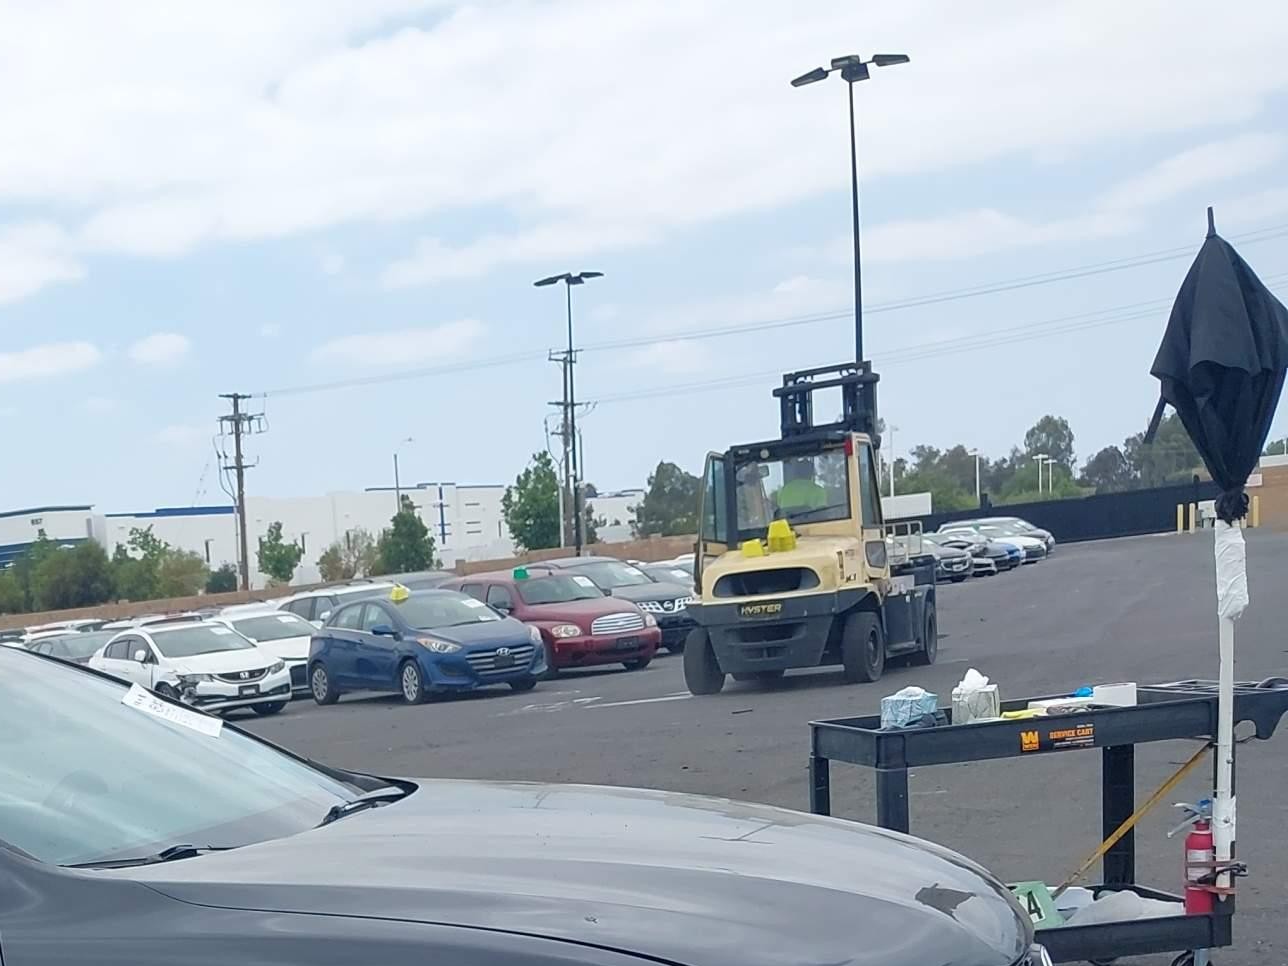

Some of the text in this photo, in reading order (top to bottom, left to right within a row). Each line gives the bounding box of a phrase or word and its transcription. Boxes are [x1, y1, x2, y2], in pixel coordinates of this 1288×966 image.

[741, 603, 781, 615] HYSTER
[1076, 727, 1094, 736] CART
[1016, 890, 1044, 920] 4
